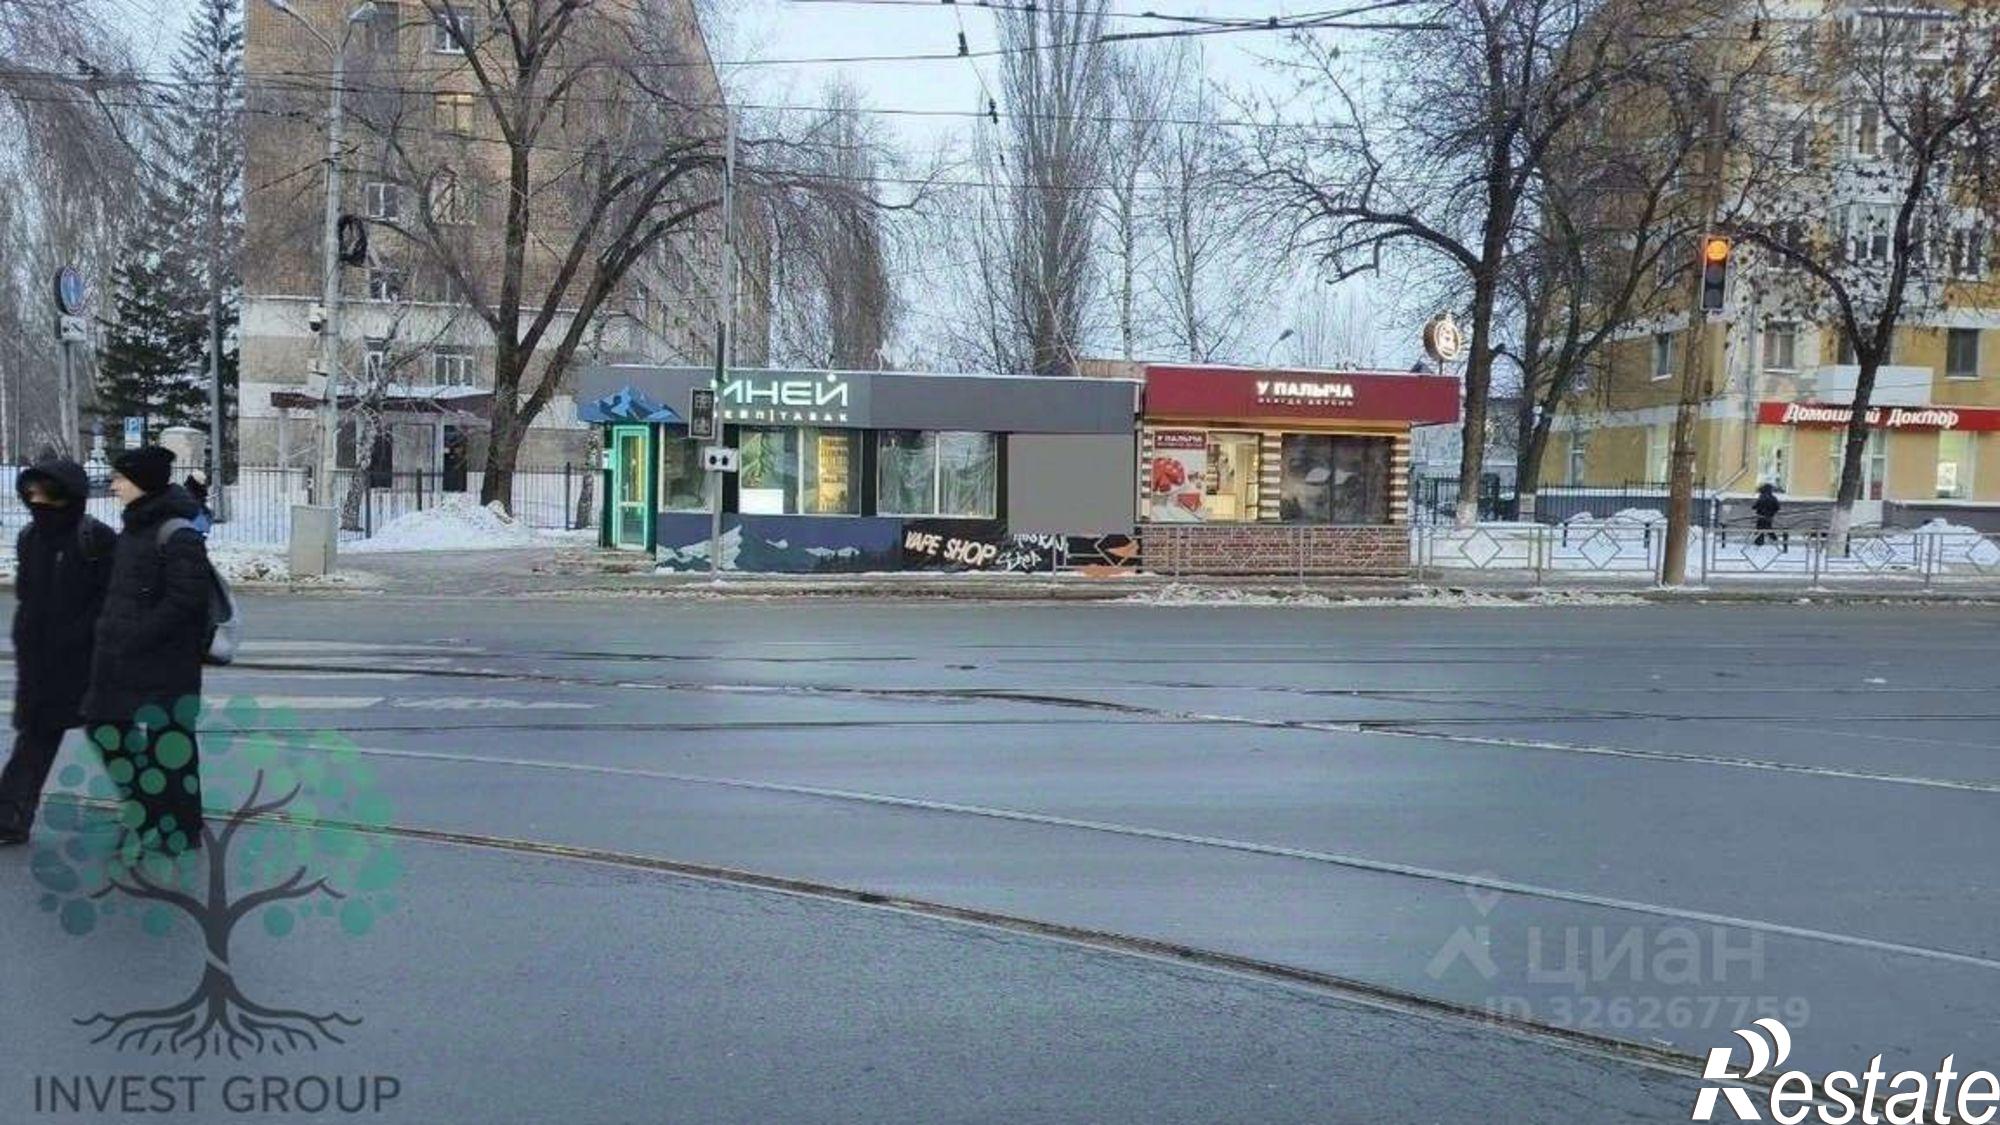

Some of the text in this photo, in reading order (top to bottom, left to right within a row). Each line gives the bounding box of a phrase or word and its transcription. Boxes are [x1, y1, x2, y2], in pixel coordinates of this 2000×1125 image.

[1256, 381, 1354, 398] У ПАЛЫЧА
[1782, 403, 1959, 430] Домашй Доктор
[904, 531, 998, 566] VAPE SHOP
